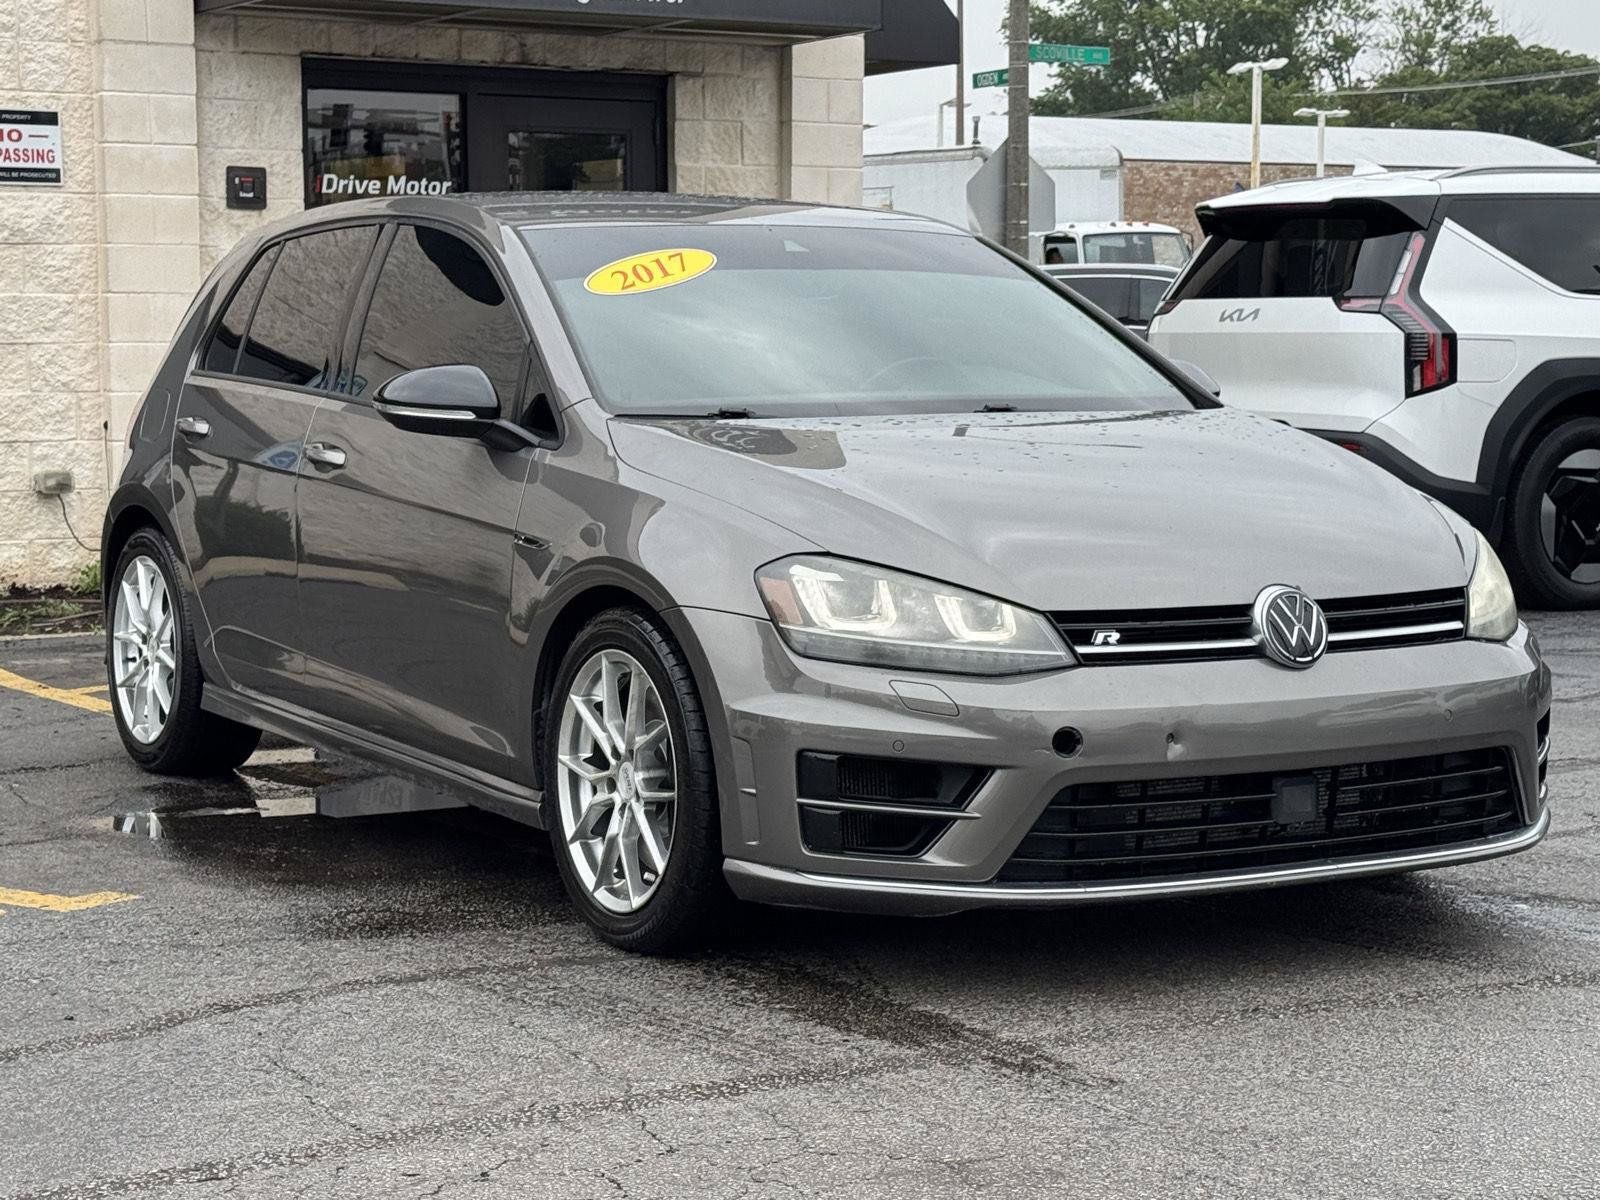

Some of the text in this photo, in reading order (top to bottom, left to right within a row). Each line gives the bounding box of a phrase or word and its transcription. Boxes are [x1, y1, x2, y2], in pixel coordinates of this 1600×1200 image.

[1035, 46, 1085, 61] SCOVILLE
[976, 71, 998, 87] OGDEN
[386, 174, 453, 196] Motor
[610, 252, 687, 291] 2017
[1090, 629, 1121, 646] R
